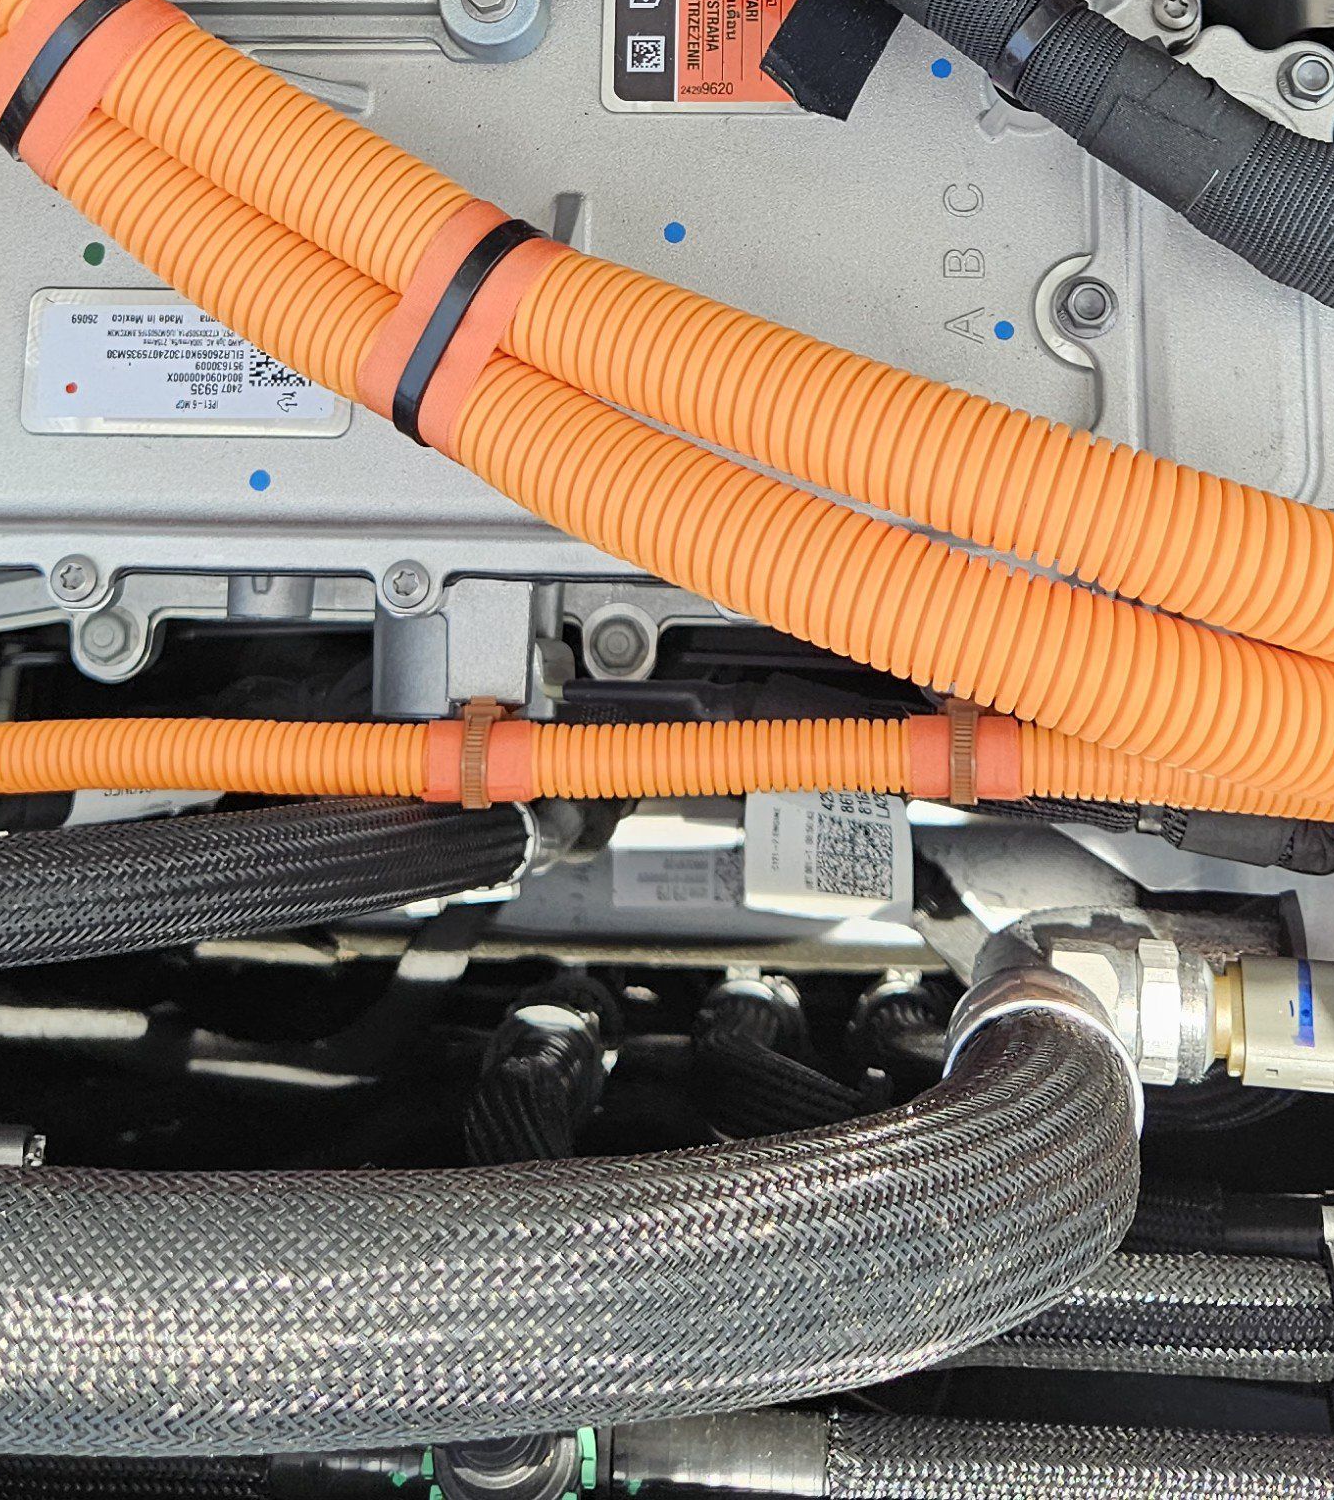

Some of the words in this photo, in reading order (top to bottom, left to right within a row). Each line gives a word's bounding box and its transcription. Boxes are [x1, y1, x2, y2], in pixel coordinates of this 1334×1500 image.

[681, 82, 734, 95] 24299620
[942, 182, 985, 218] C
[943, 247, 986, 279] B
[71, 314, 98, 324] 26069
[112, 314, 144, 324] Mexico
[158, 314, 183, 324] Made
[943, 306, 986, 344] A
[195, 362, 244, 370] 951630009
[190, 384, 218, 395] 5935
[222, 384, 243, 393] 2407
